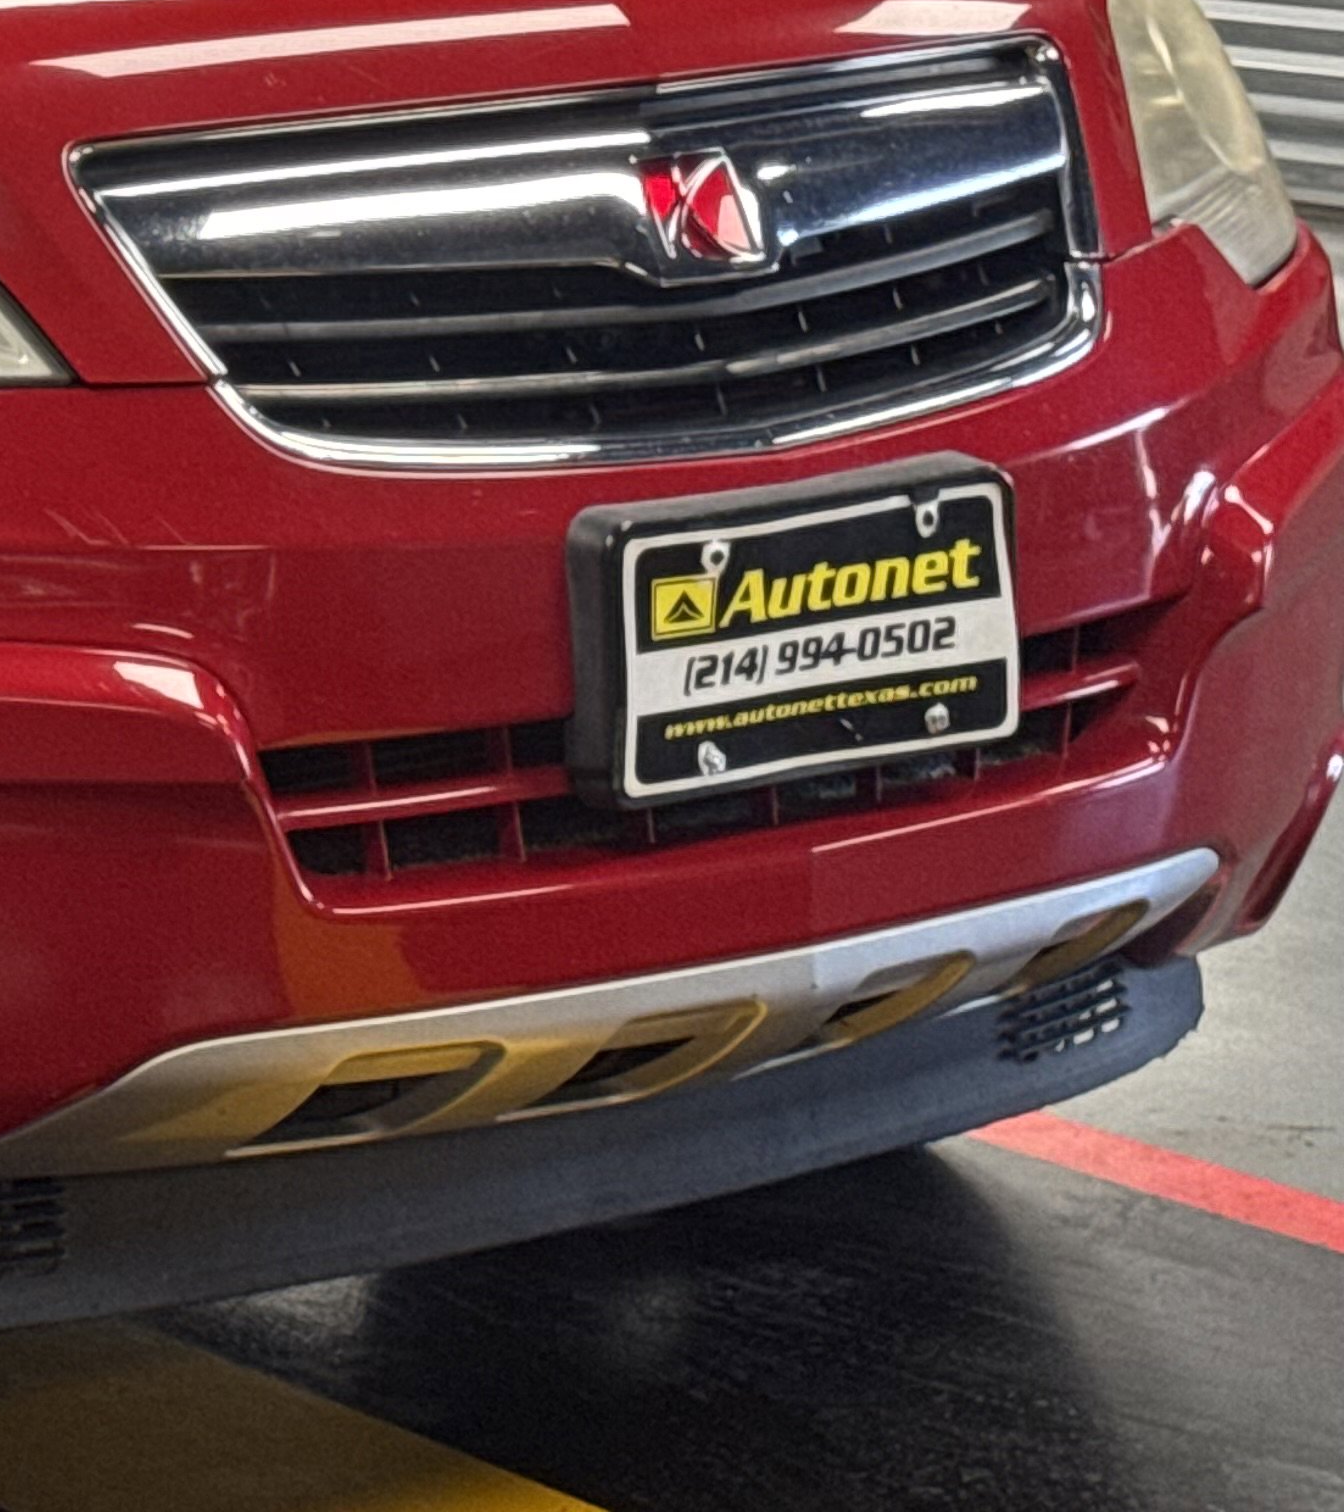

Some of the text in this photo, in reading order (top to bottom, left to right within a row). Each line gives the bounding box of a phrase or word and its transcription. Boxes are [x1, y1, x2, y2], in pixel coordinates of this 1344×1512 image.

[719, 538, 981, 628] Autonet
[685, 616, 957, 696] (214) 994-0502
[664, 675, 977, 740] www.autonettexas.com
